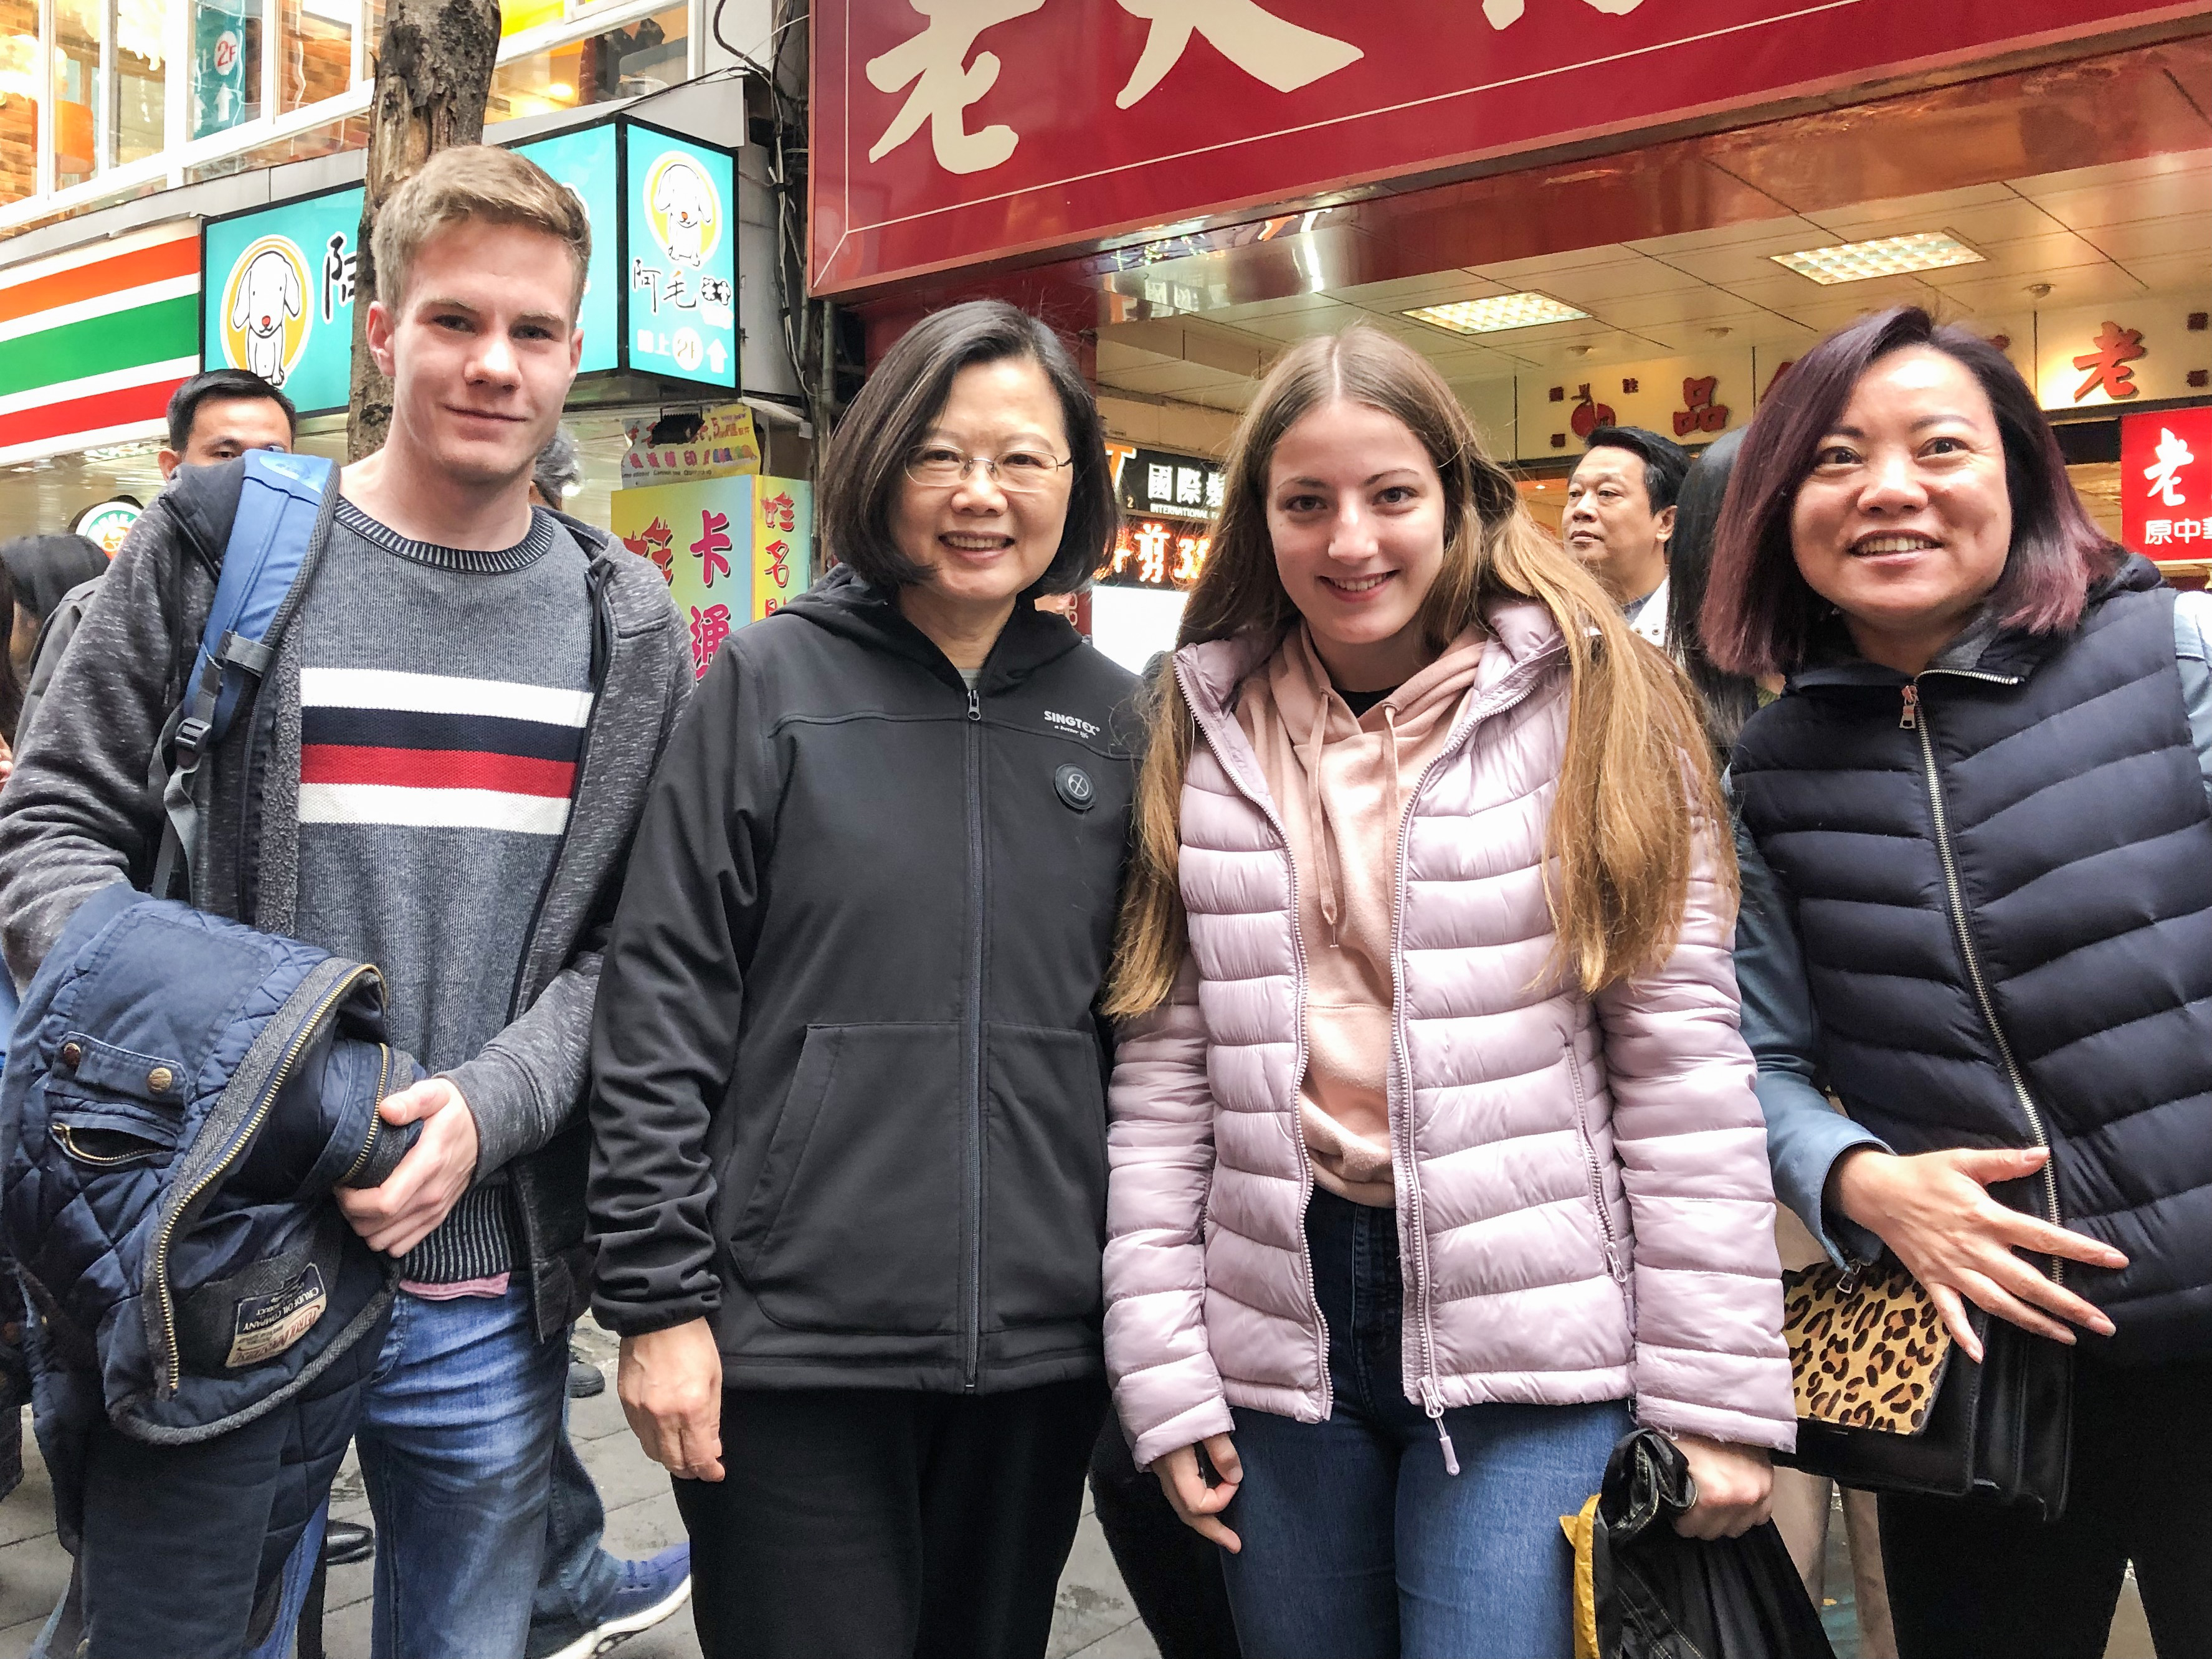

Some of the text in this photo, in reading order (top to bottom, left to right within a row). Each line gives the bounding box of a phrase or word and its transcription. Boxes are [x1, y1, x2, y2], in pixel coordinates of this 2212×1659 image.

[217, 40, 236, 66] 2F
[2073, 321, 2147, 403] 老
[1673, 376, 1728, 437] 品
[1150, 503, 1208, 520] INTERNATIONAL
[242, 1311, 282, 1331] COMPANY
